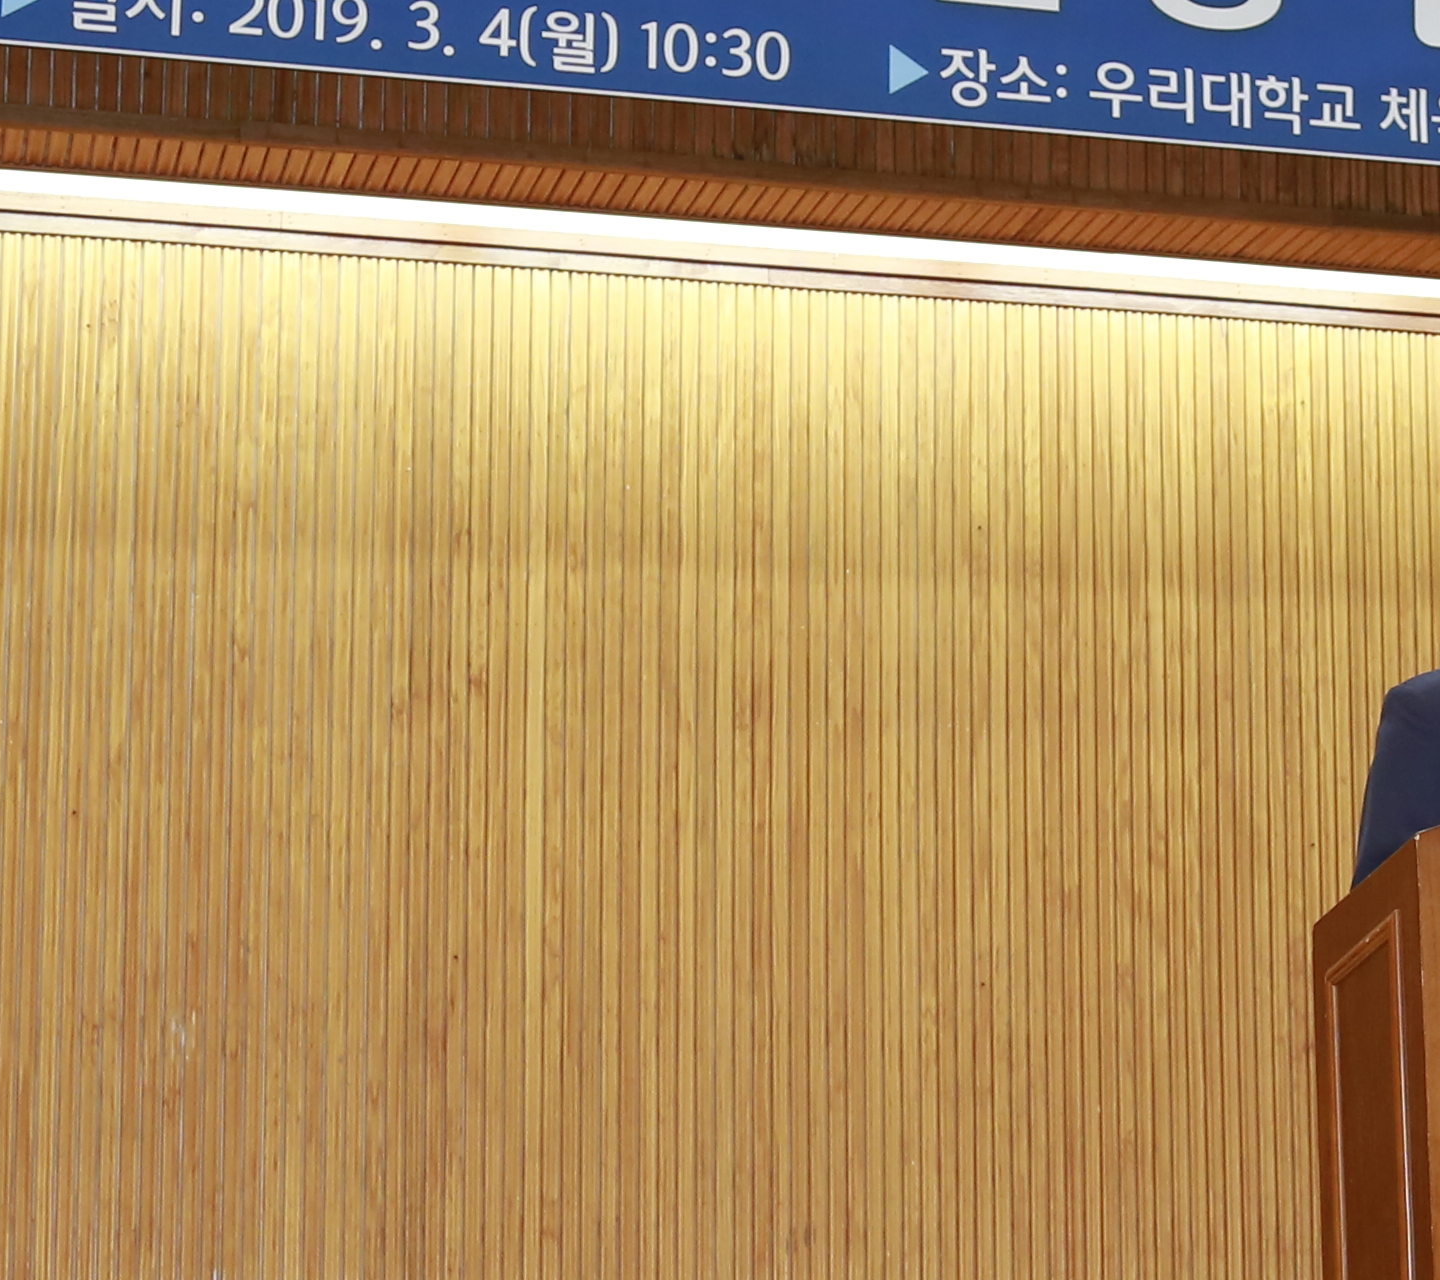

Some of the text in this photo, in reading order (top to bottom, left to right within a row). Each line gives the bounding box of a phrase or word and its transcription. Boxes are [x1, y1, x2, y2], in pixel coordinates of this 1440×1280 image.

[406, 0, 456, 58] 3.
[477, 4, 620, 74] 4(월)
[640, 21, 791, 81] 10:30
[939, 46, 1069, 109] 장소:
[1087, 61, 1362, 136] 우리대학교
